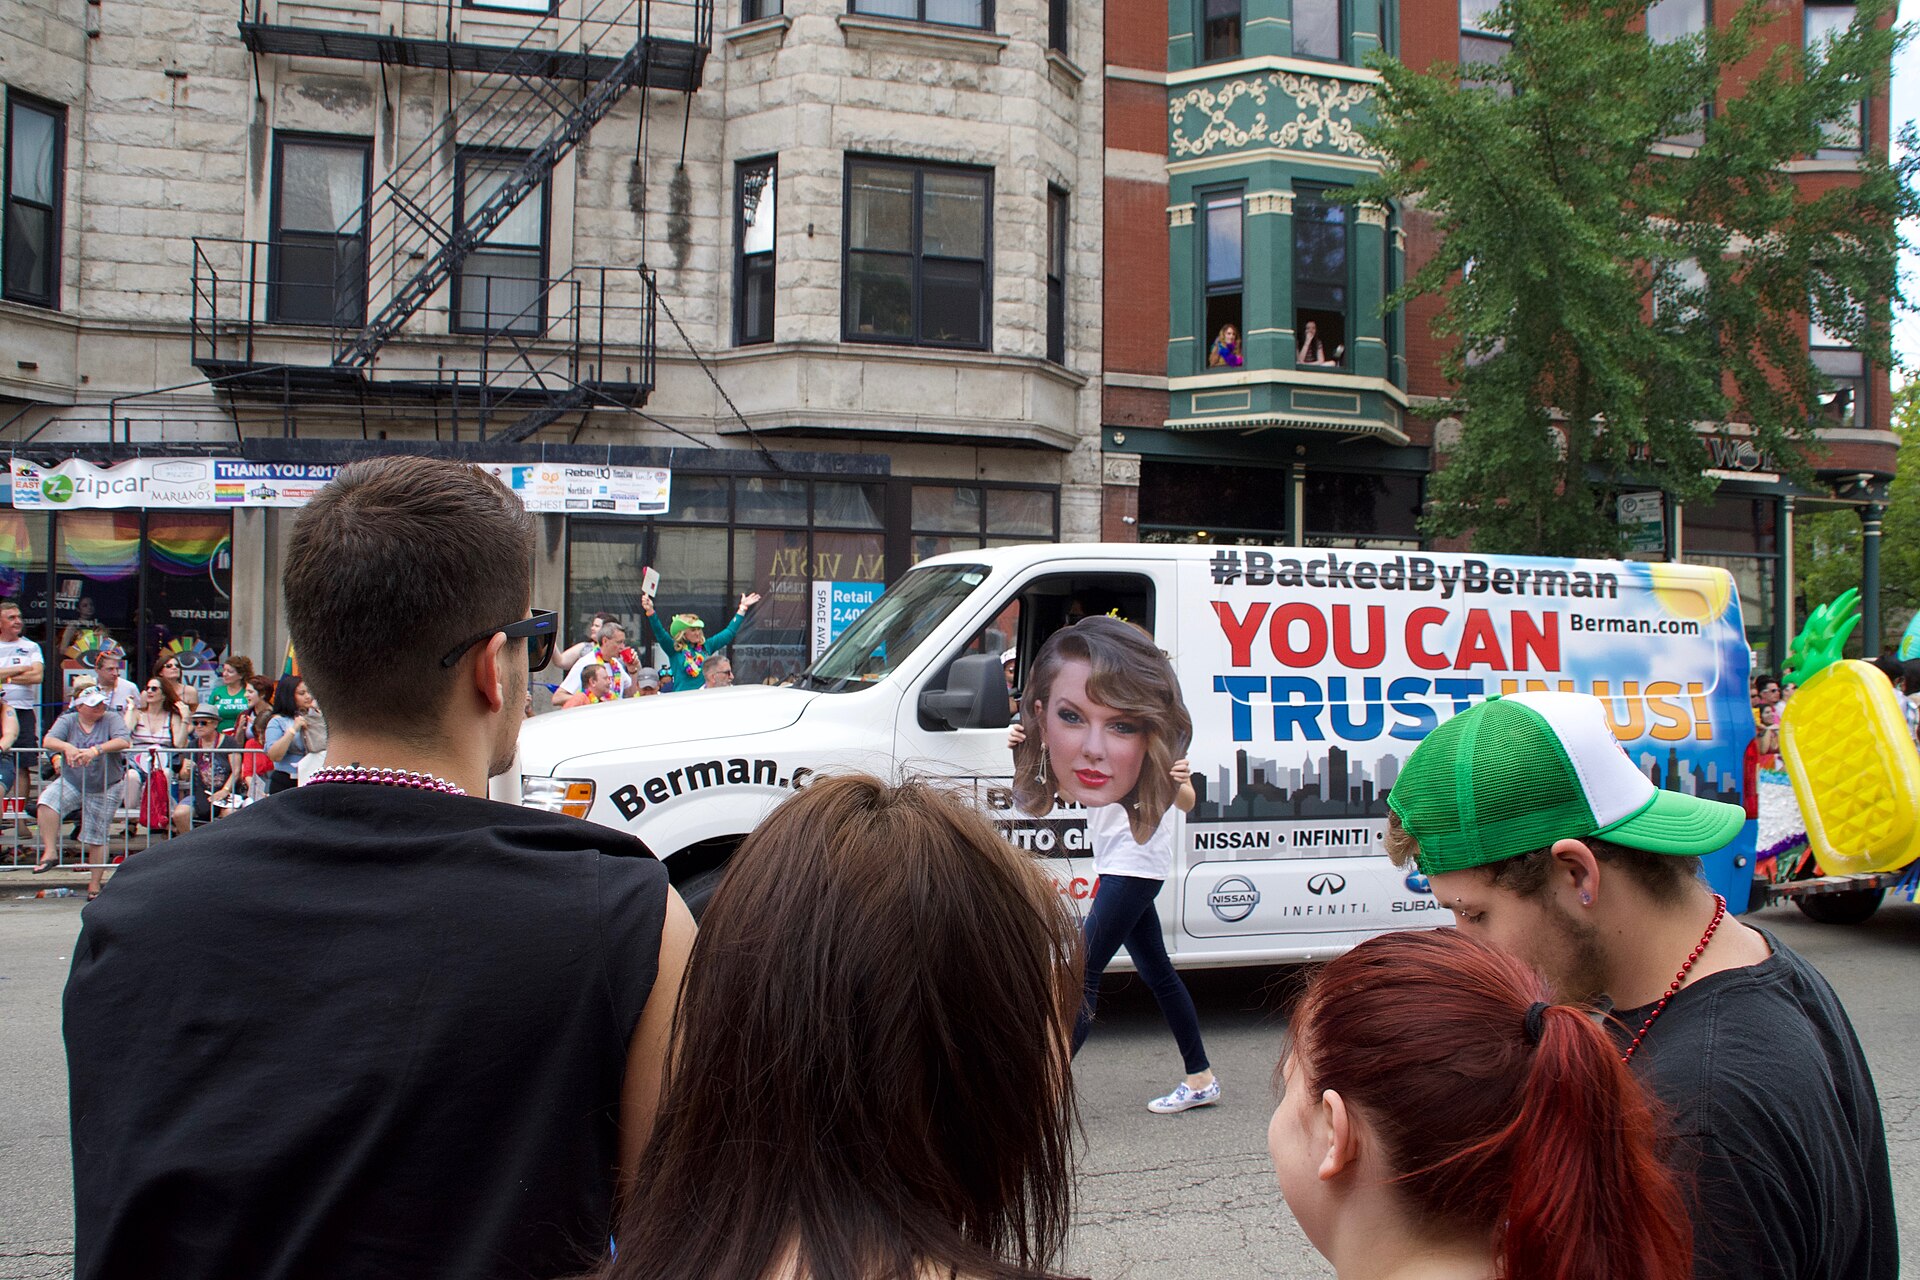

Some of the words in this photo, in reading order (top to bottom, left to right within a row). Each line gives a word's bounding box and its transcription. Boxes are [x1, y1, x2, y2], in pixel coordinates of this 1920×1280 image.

[217, 463, 271, 477] THANK
[273, 463, 305, 477] YOU
[307, 465, 340, 478] 2017
[15, 481, 39, 489] EAST
[75, 474, 150, 499] zipcar
[151, 489, 211, 504] MARIANO'S
[1209, 550, 1618, 599] #BackedByBerman
[833, 590, 873, 603] Retail
[816, 590, 827, 623] SPACE
[833, 608, 866, 622] 2,40
[1570, 613, 1699, 635] Berman.com
[1210, 600, 1387, 670] YOU
[1404, 606, 1561, 672] CAN
[183, 675, 211, 688] VE
[1213, 675, 1484, 742] TRUST
[1593, 680, 1714, 741] US!
[1194, 831, 1270, 850] NISSAN
[1292, 828, 1369, 848] INFINITI
[1212, 893, 1256, 904] NISSAN
[1391, 899, 1441, 913] SUBA
[1283, 903, 1369, 917] INFINITI
